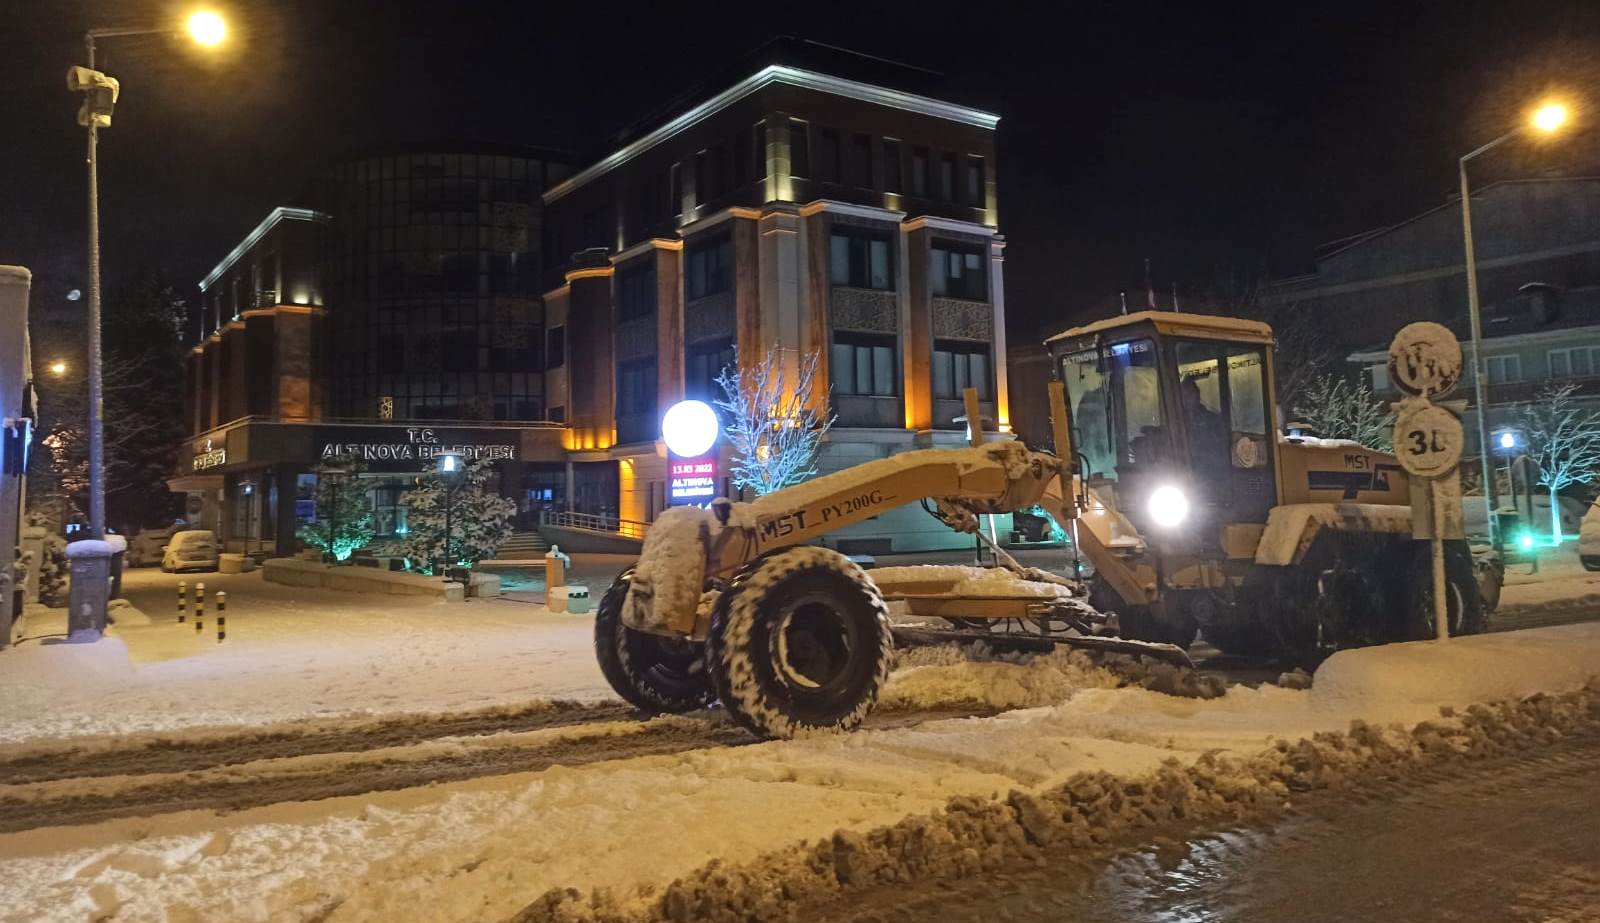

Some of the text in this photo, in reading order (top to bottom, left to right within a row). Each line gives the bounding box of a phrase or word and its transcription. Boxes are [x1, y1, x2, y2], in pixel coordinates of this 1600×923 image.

[407, 427, 439, 444] T.C.
[322, 443, 415, 460] ALTNOVA
[1343, 454, 1370, 470] MST
